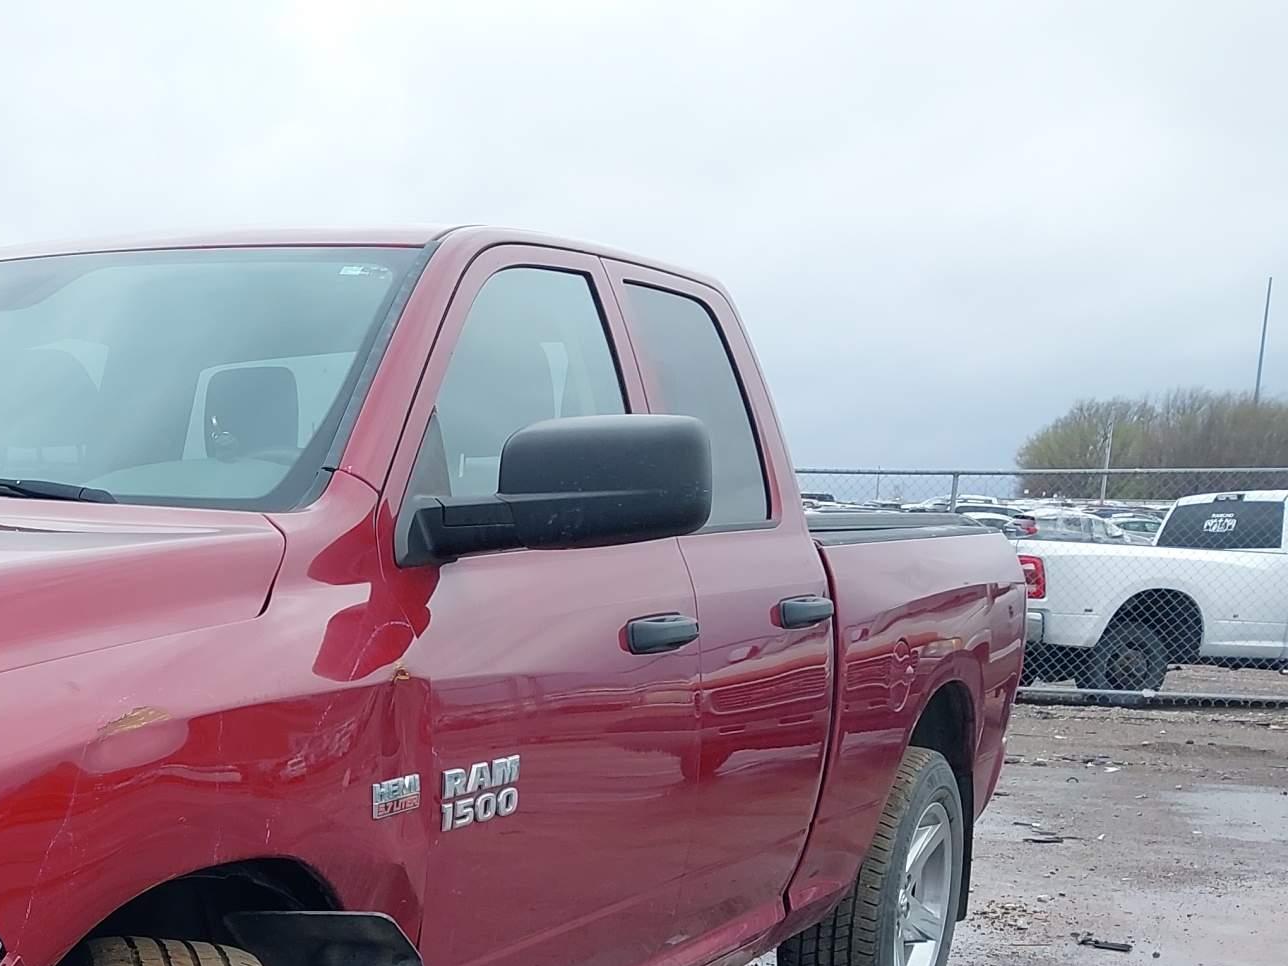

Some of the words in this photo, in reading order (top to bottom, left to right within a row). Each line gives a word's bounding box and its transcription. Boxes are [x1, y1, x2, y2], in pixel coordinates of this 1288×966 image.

[373, 773, 420, 803] HEMI
[442, 754, 521, 799] RAM
[377, 802, 392, 817] 5.7
[393, 796, 419, 812] LITER
[441, 787, 519, 832] 1500
